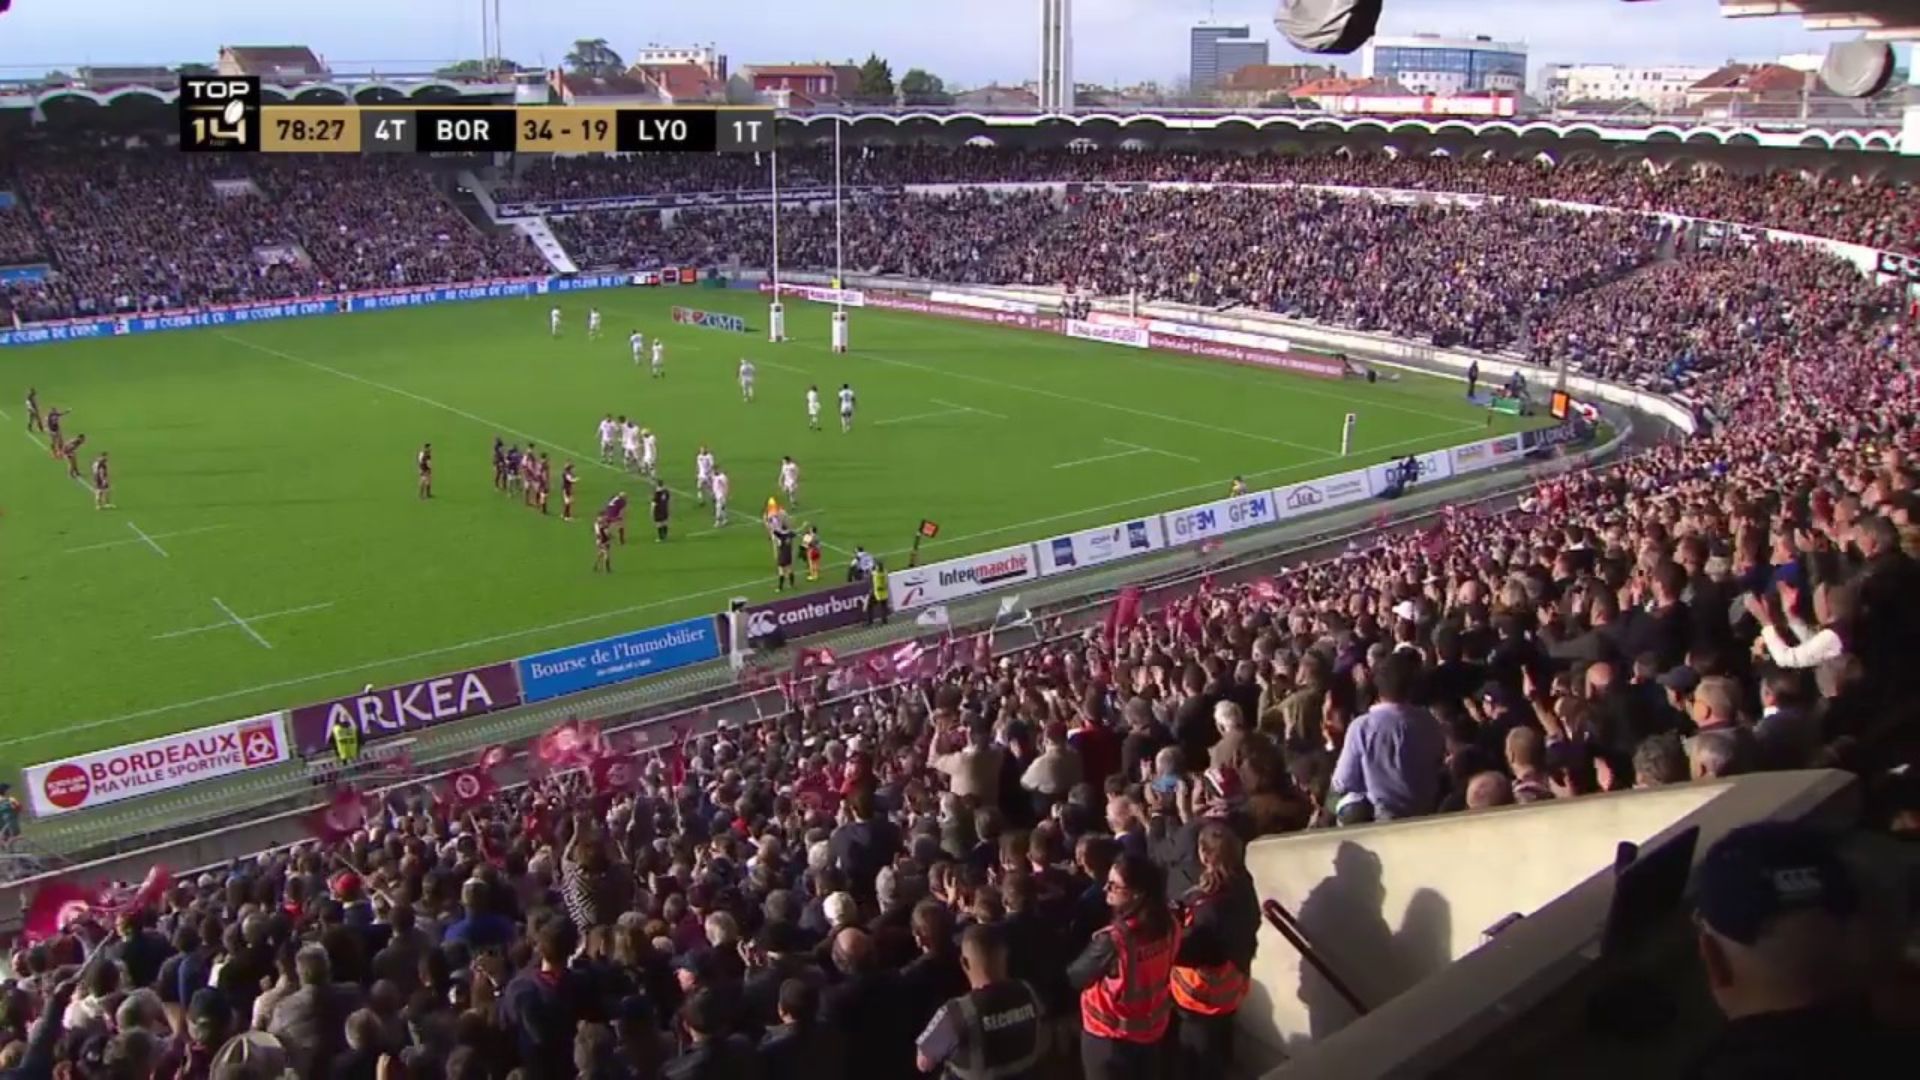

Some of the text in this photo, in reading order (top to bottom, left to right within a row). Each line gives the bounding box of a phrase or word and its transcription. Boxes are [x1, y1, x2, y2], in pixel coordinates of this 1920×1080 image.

[1174, 509, 1216, 536] GF3M
[1228, 497, 1267, 523] GF3M
[778, 592, 870, 625] canterbury
[530, 660, 587, 680] Bourse
[591, 648, 610, 665] de
[324, 672, 493, 746] ARKEA
[91, 732, 238, 781] BORDEAUX
[93, 780, 119, 796] MA
[119, 769, 165, 788] VILLE
[167, 751, 242, 778] SPORTIVE
